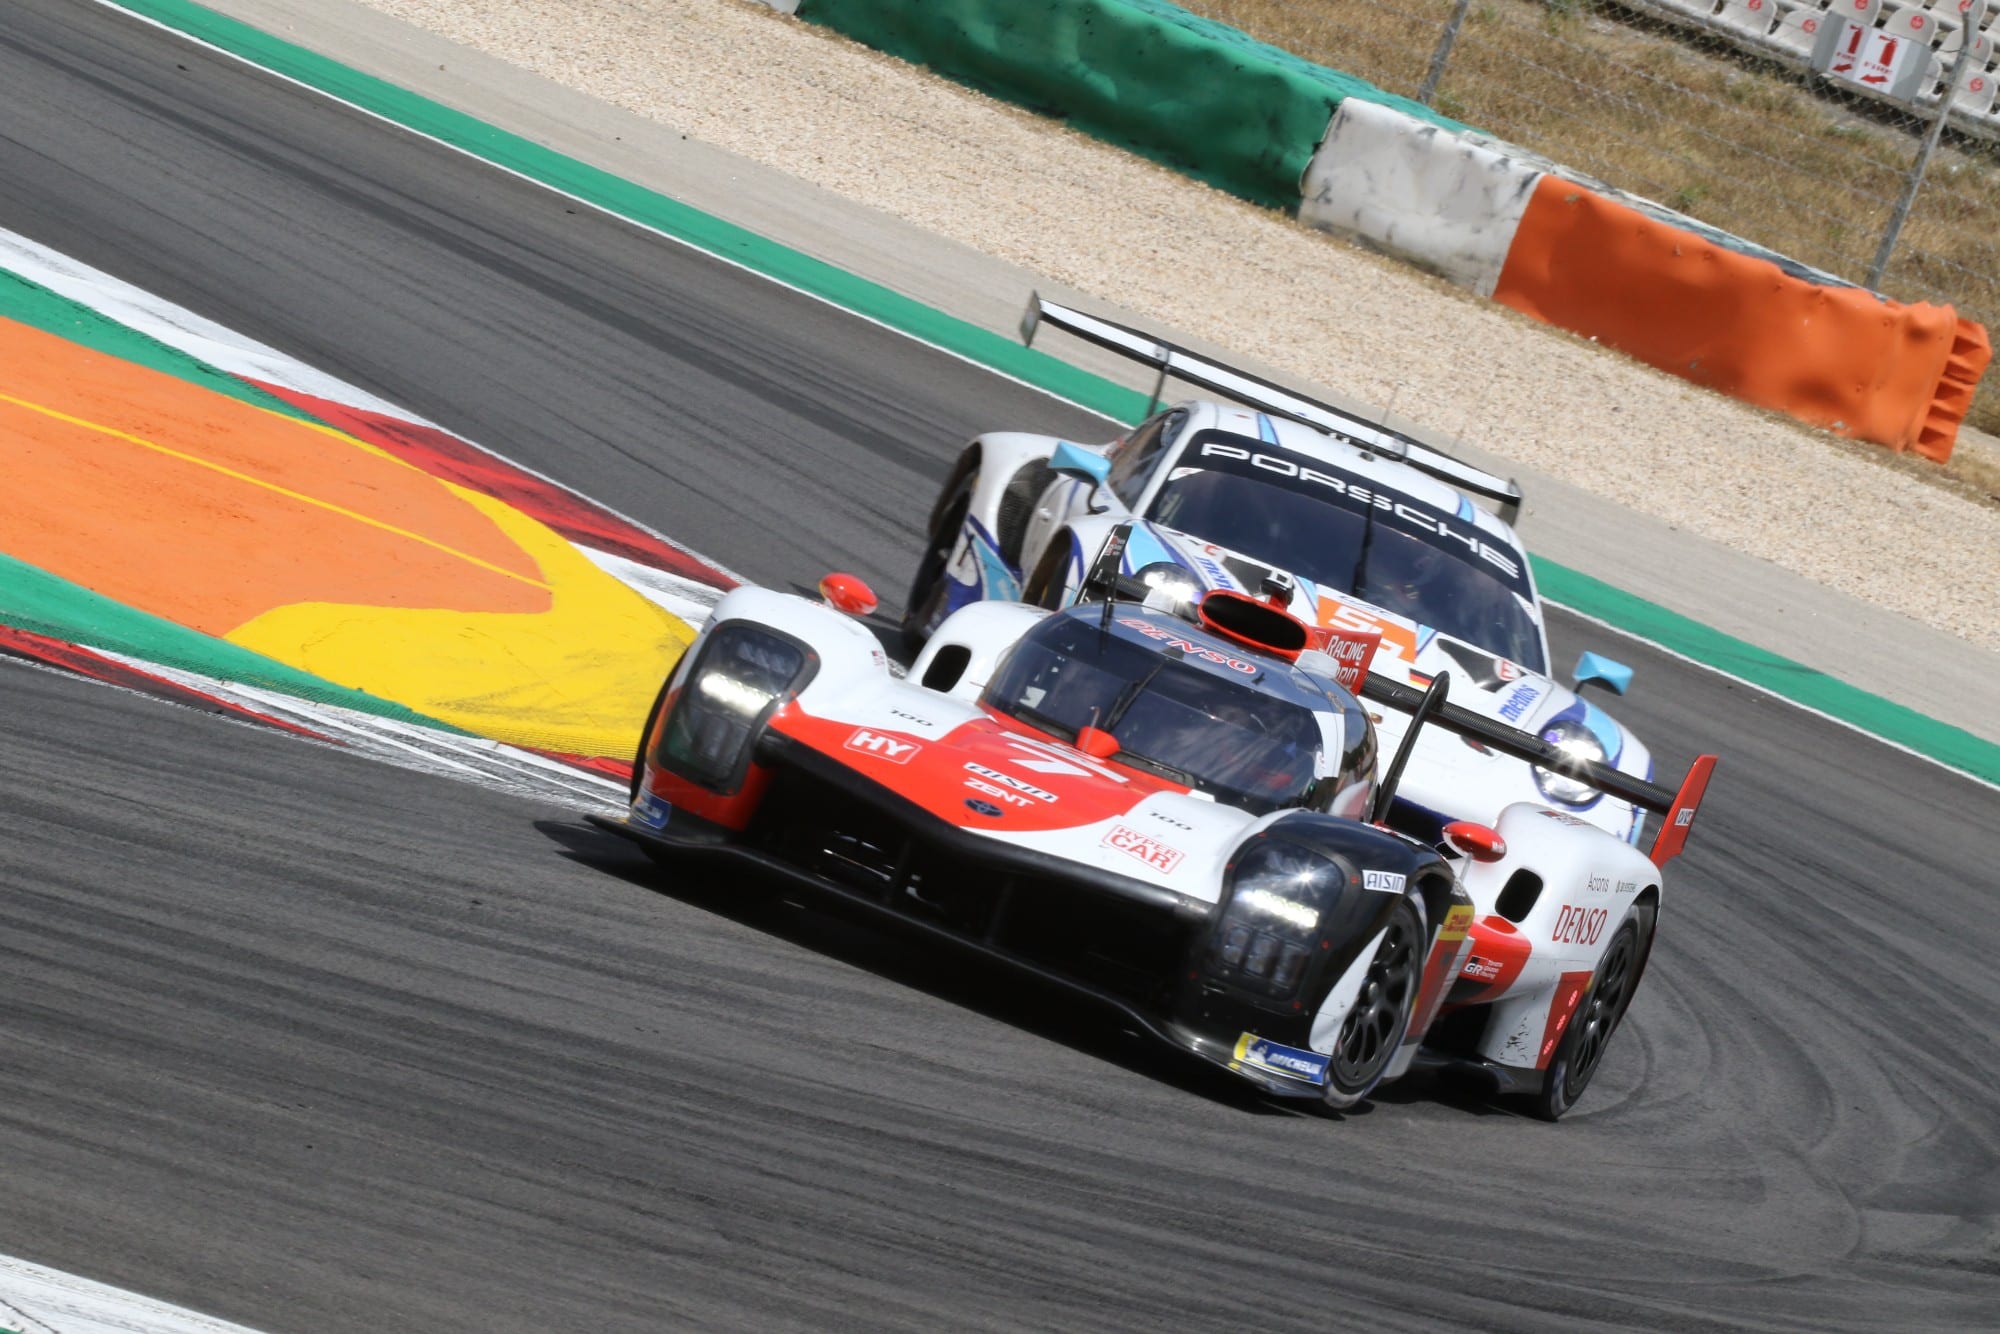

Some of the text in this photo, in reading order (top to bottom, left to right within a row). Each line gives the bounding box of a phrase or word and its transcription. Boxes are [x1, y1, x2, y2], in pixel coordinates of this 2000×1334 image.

[1201, 443, 1520, 579] PORSCHE
[1115, 619, 1256, 674] DENSO
[1327, 634, 1367, 661] RACING
[851, 731, 915, 756] HY
[963, 777, 1035, 807] ZENT
[967, 764, 1053, 800] AISIN
[1110, 834, 1171, 869] CAR
[1117, 828, 1178, 858] HYPER
[1367, 872, 1405, 892] AISIN
[1552, 904, 1608, 946] DENSO
[1464, 962, 1484, 976] GR
